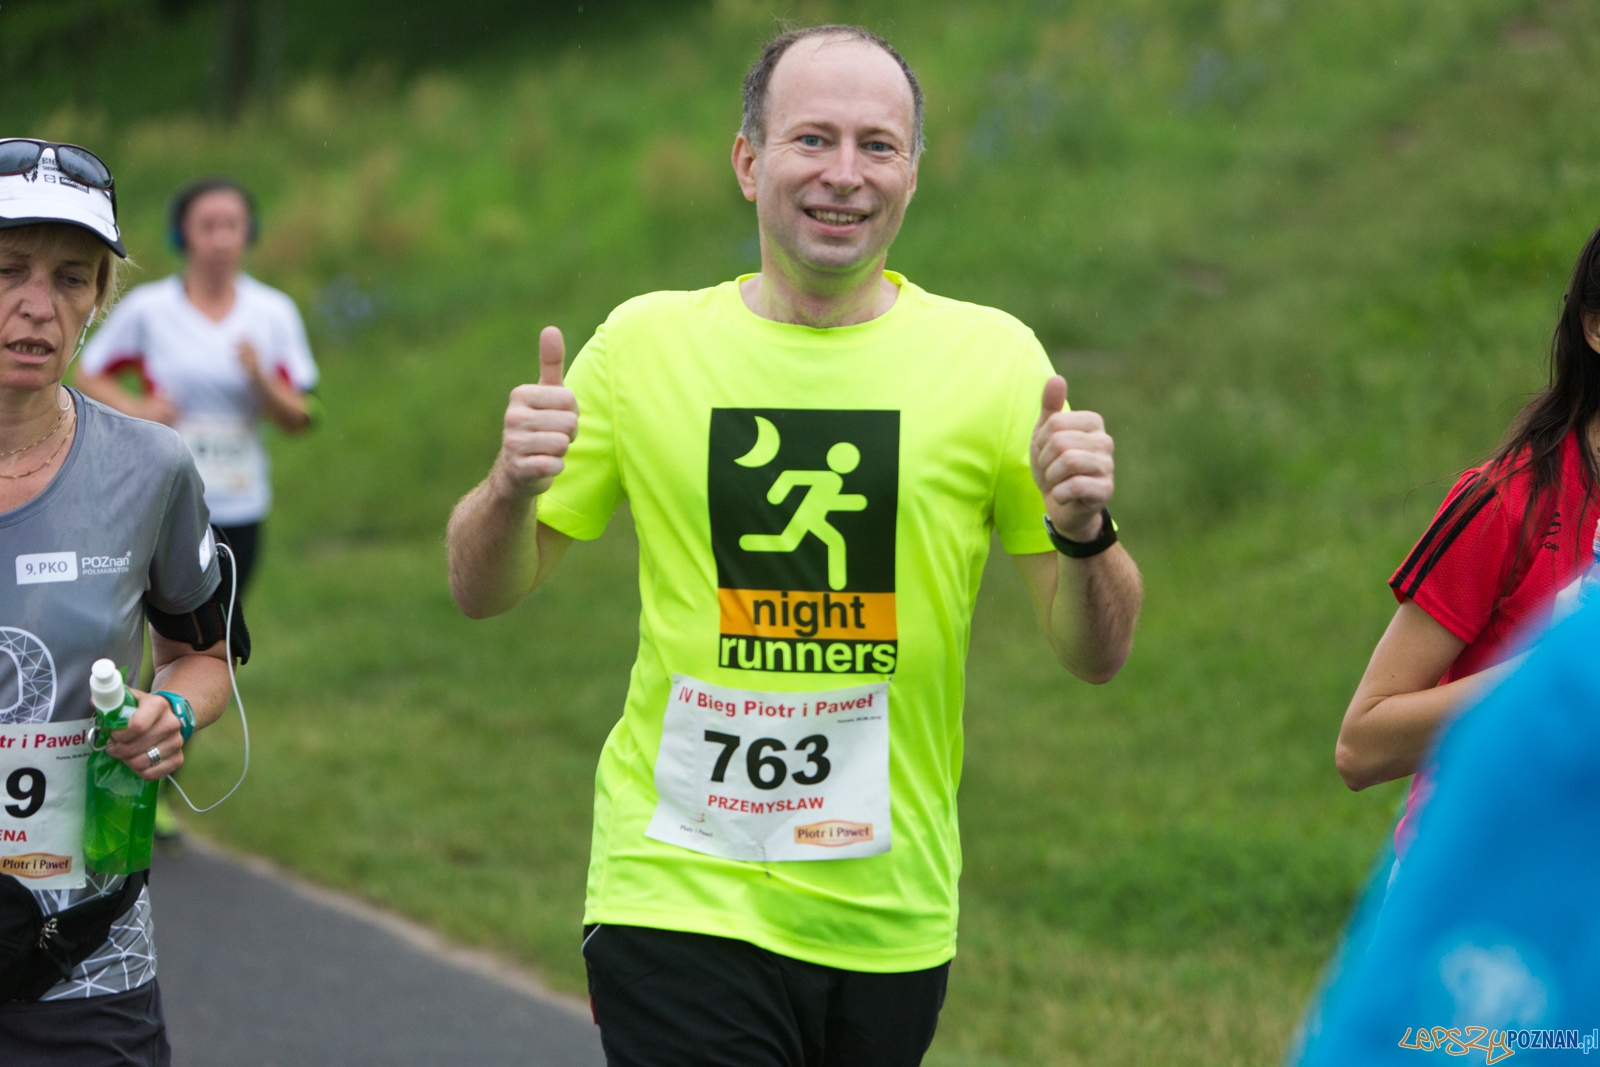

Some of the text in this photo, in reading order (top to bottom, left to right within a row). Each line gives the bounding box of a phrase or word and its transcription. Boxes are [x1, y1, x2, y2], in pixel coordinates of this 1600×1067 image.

[25, 561, 68, 576] 9. PKO
[753, 590, 866, 637] night
[720, 637, 897, 672] runners
[678, 686, 874, 718] IV Bieg Piotr i Paweł
[22, 734, 28, 749] i
[34, 729, 87, 749] Paweł
[704, 729, 831, 790] 763
[707, 795, 824, 814] PRZEMYSŁAW
[797, 826, 869, 840] Piotr i Paweł
[2, 859, 69, 870] Piotr i Paweł
